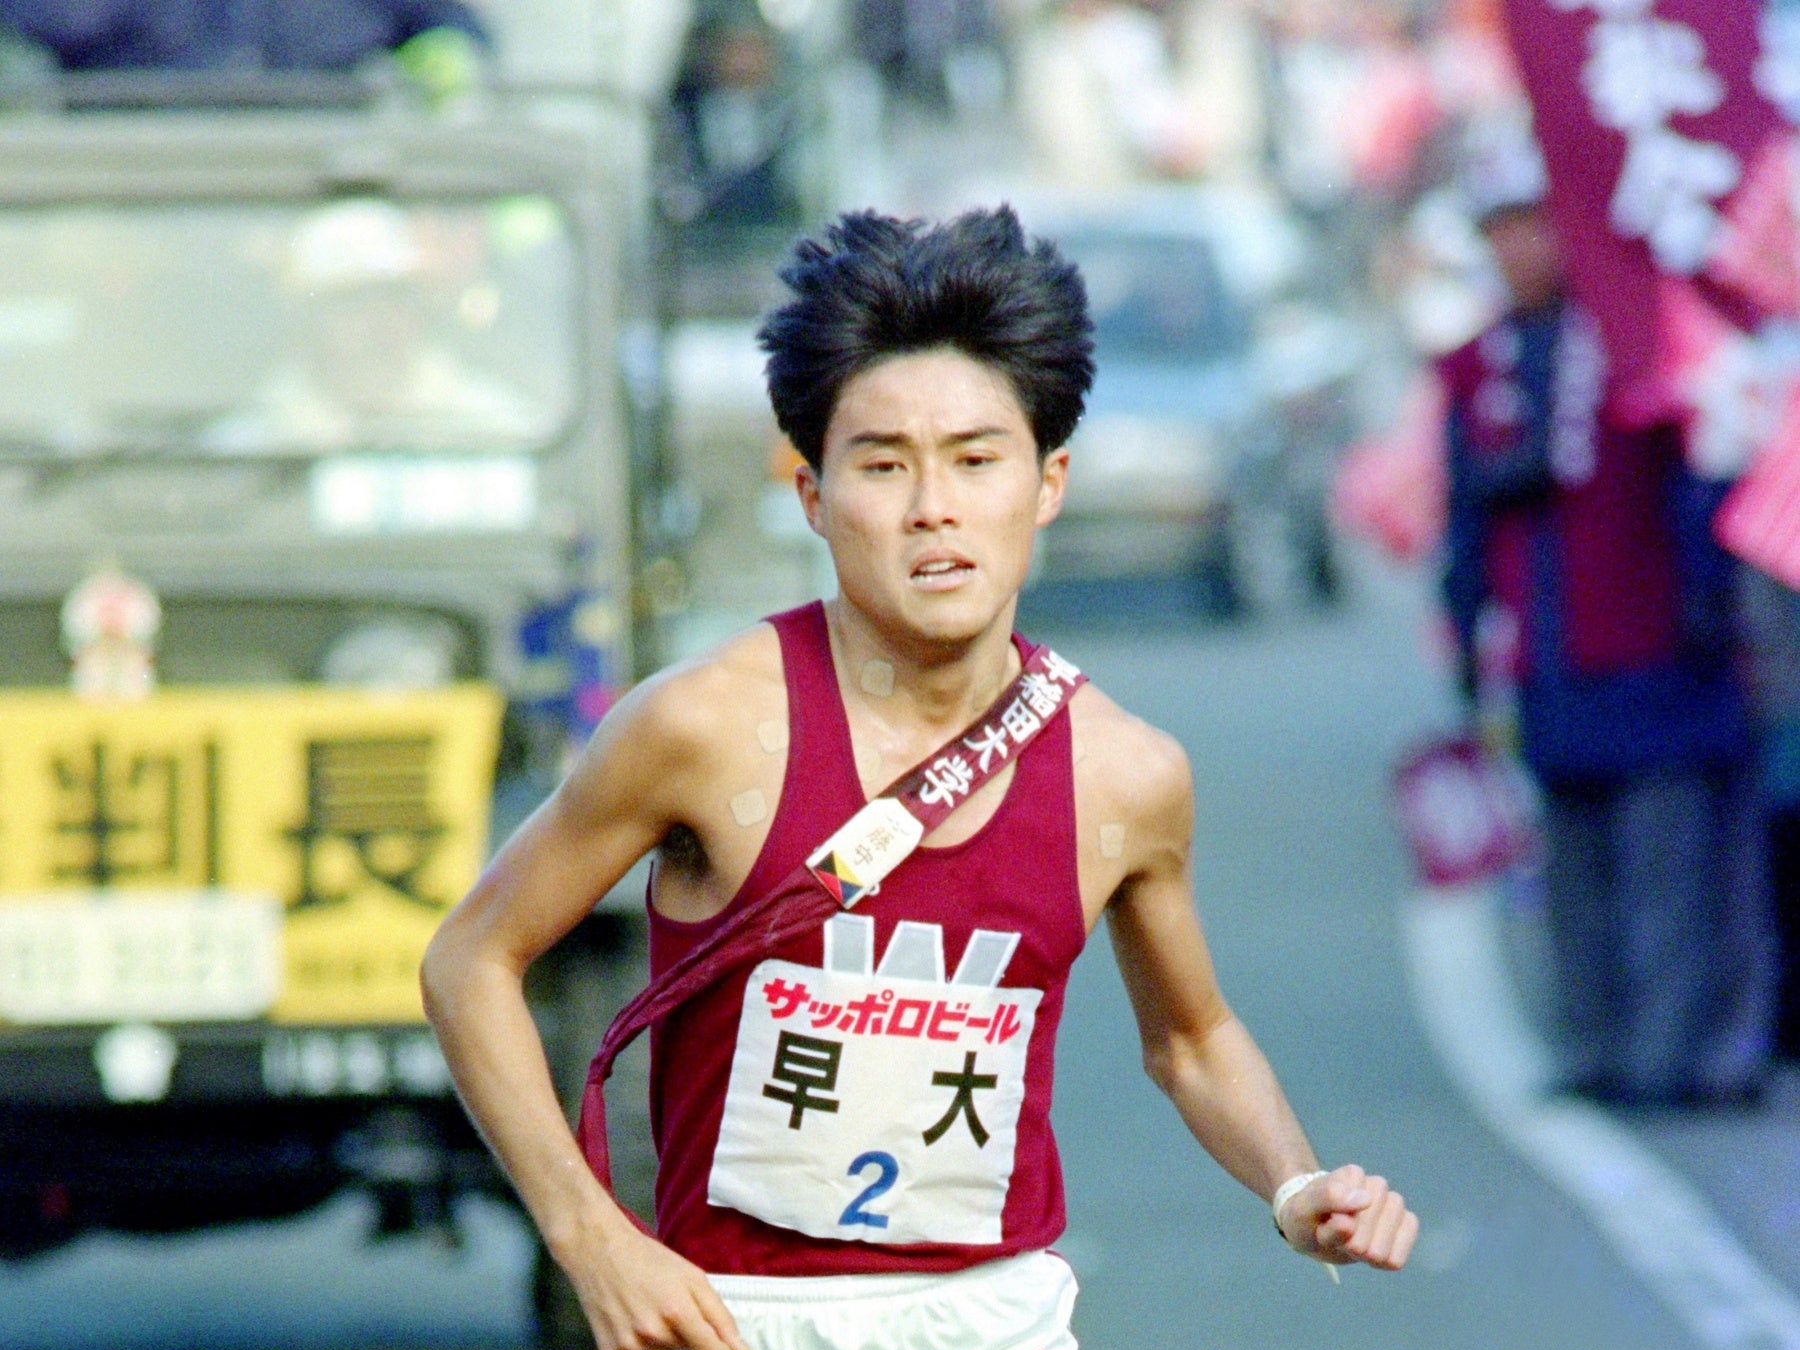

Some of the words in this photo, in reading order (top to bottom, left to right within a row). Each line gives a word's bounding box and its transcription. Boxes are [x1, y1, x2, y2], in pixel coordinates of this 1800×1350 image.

[46, 728, 452, 911] 判長
[762, 978, 1021, 1045] サッポロビール
[762, 1030, 843, 1131] 早
[922, 1051, 998, 1149] 大
[838, 1150, 899, 1229] 2
